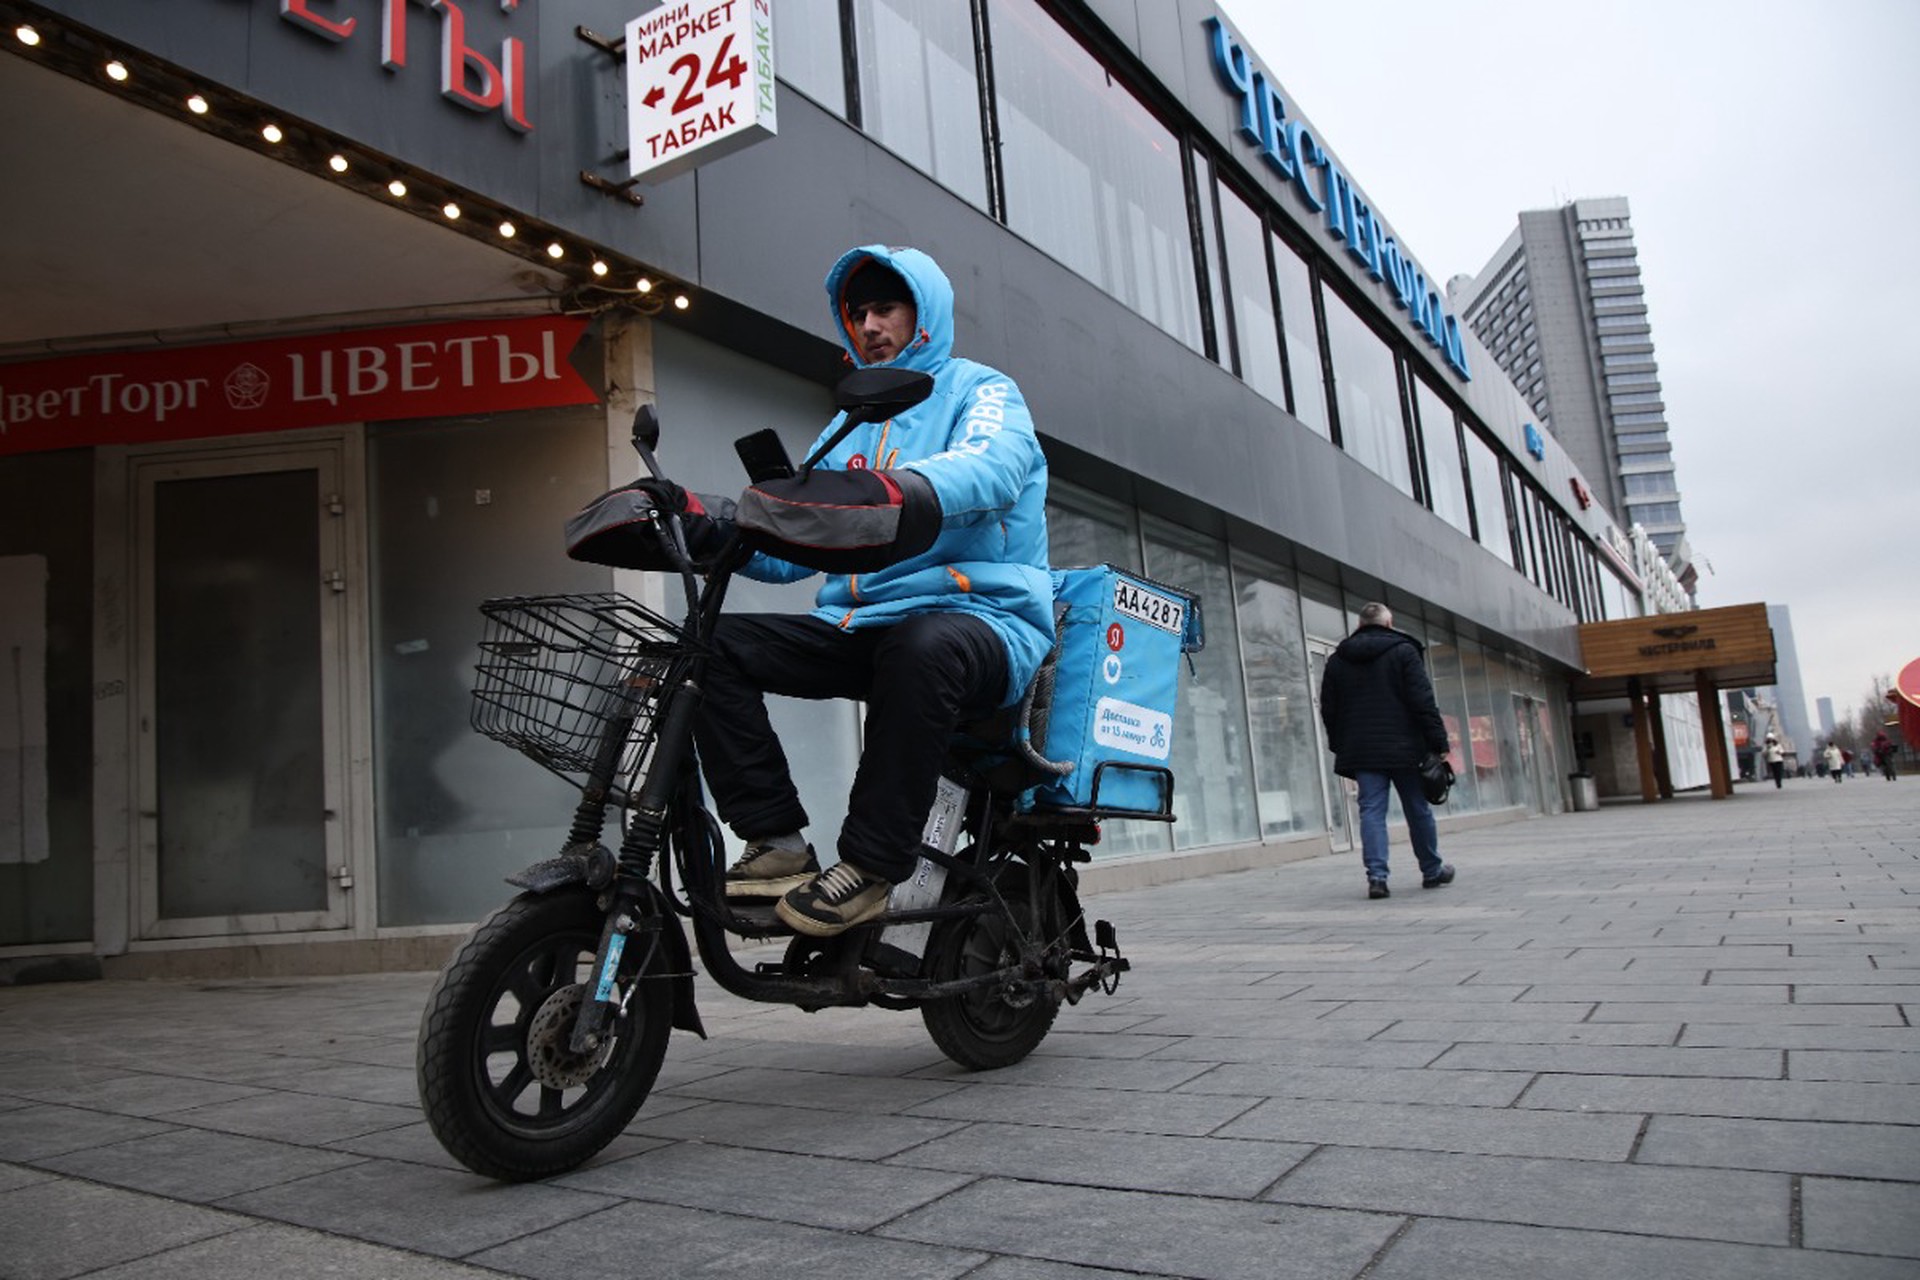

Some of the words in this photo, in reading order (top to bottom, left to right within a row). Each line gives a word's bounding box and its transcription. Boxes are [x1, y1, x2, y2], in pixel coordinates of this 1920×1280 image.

[638, 3, 690, 40] МИНИ
[639, 0, 737, 64] МАРКЕТ
[668, 32, 748, 116] 24
[755, 20, 773, 113] ТАБАК
[646, 101, 736, 159] ТАБАК
[0, 374, 209, 435] ветТорг
[286, 331, 562, 406] ЦВЕТЫ
